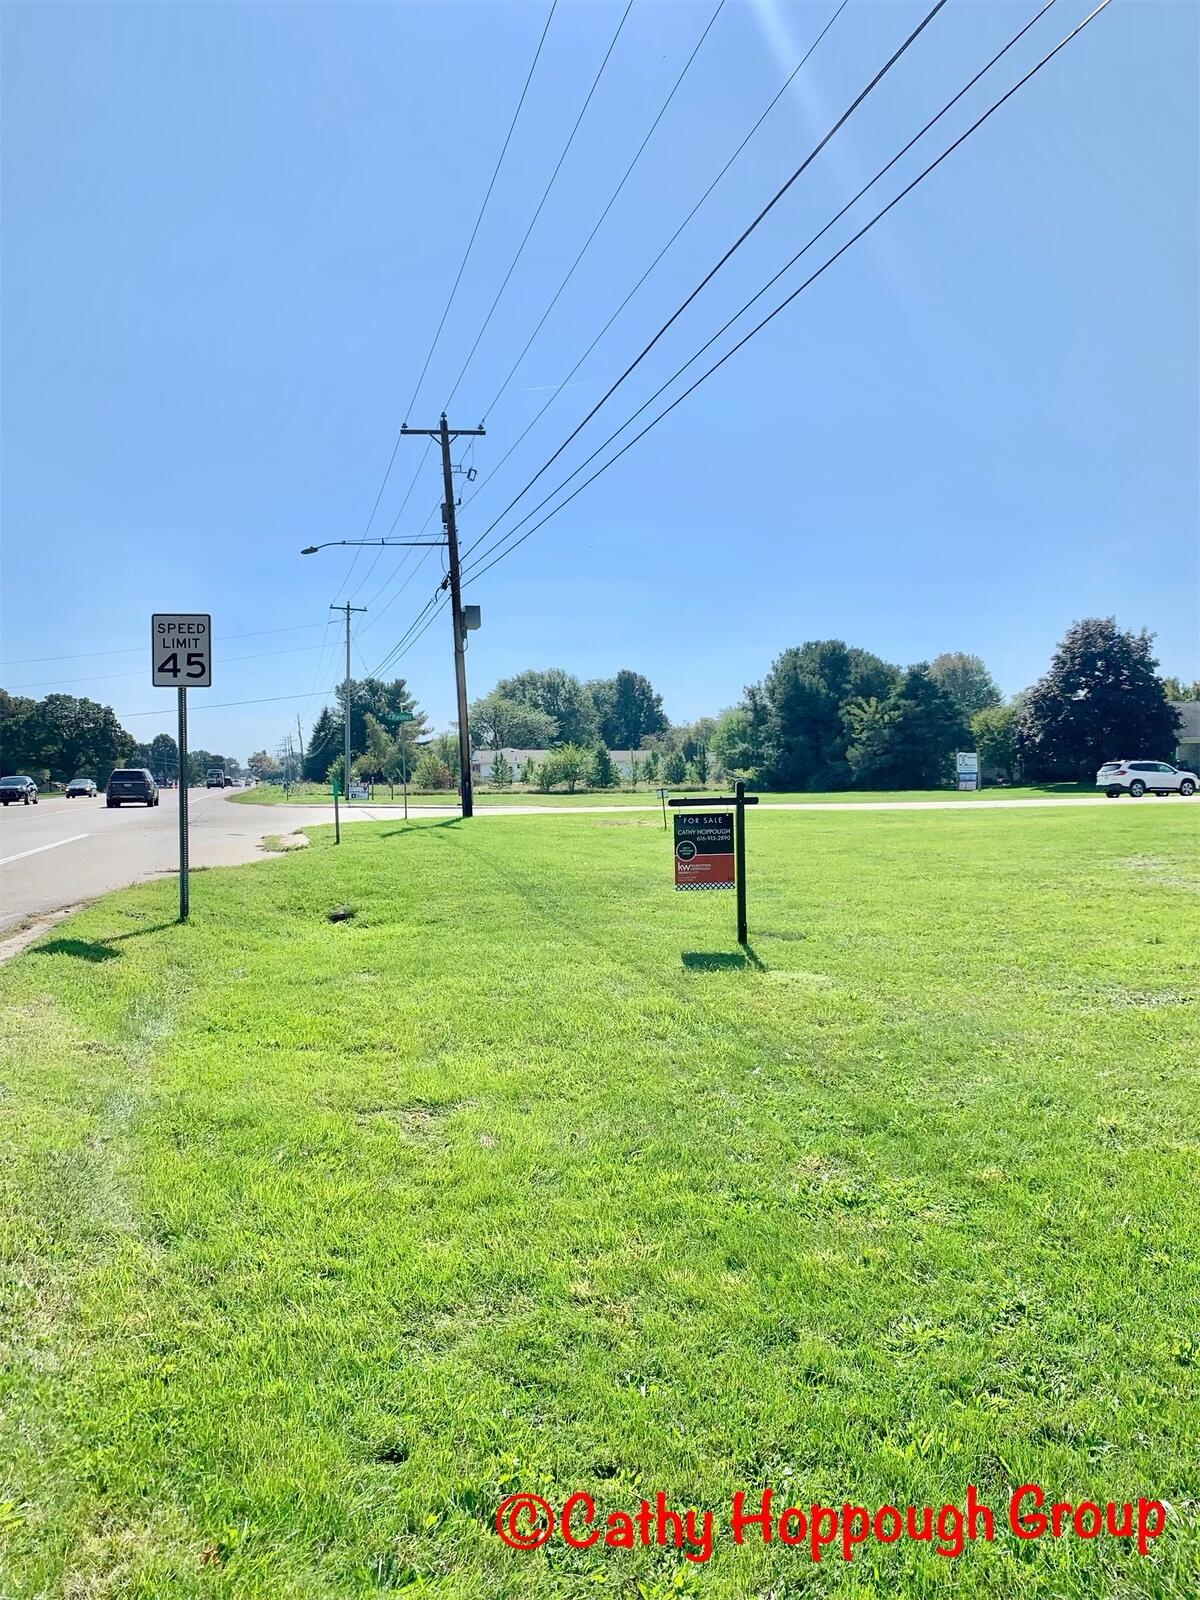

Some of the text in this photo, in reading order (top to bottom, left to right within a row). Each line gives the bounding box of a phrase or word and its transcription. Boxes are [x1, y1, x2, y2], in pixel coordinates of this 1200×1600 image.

[157, 623, 206, 634] SPEED
[162, 638, 200, 649] LIMIT
[157, 652, 206, 679] 45
[703, 816, 723, 824] SALE
[677, 862, 691, 872] kw
